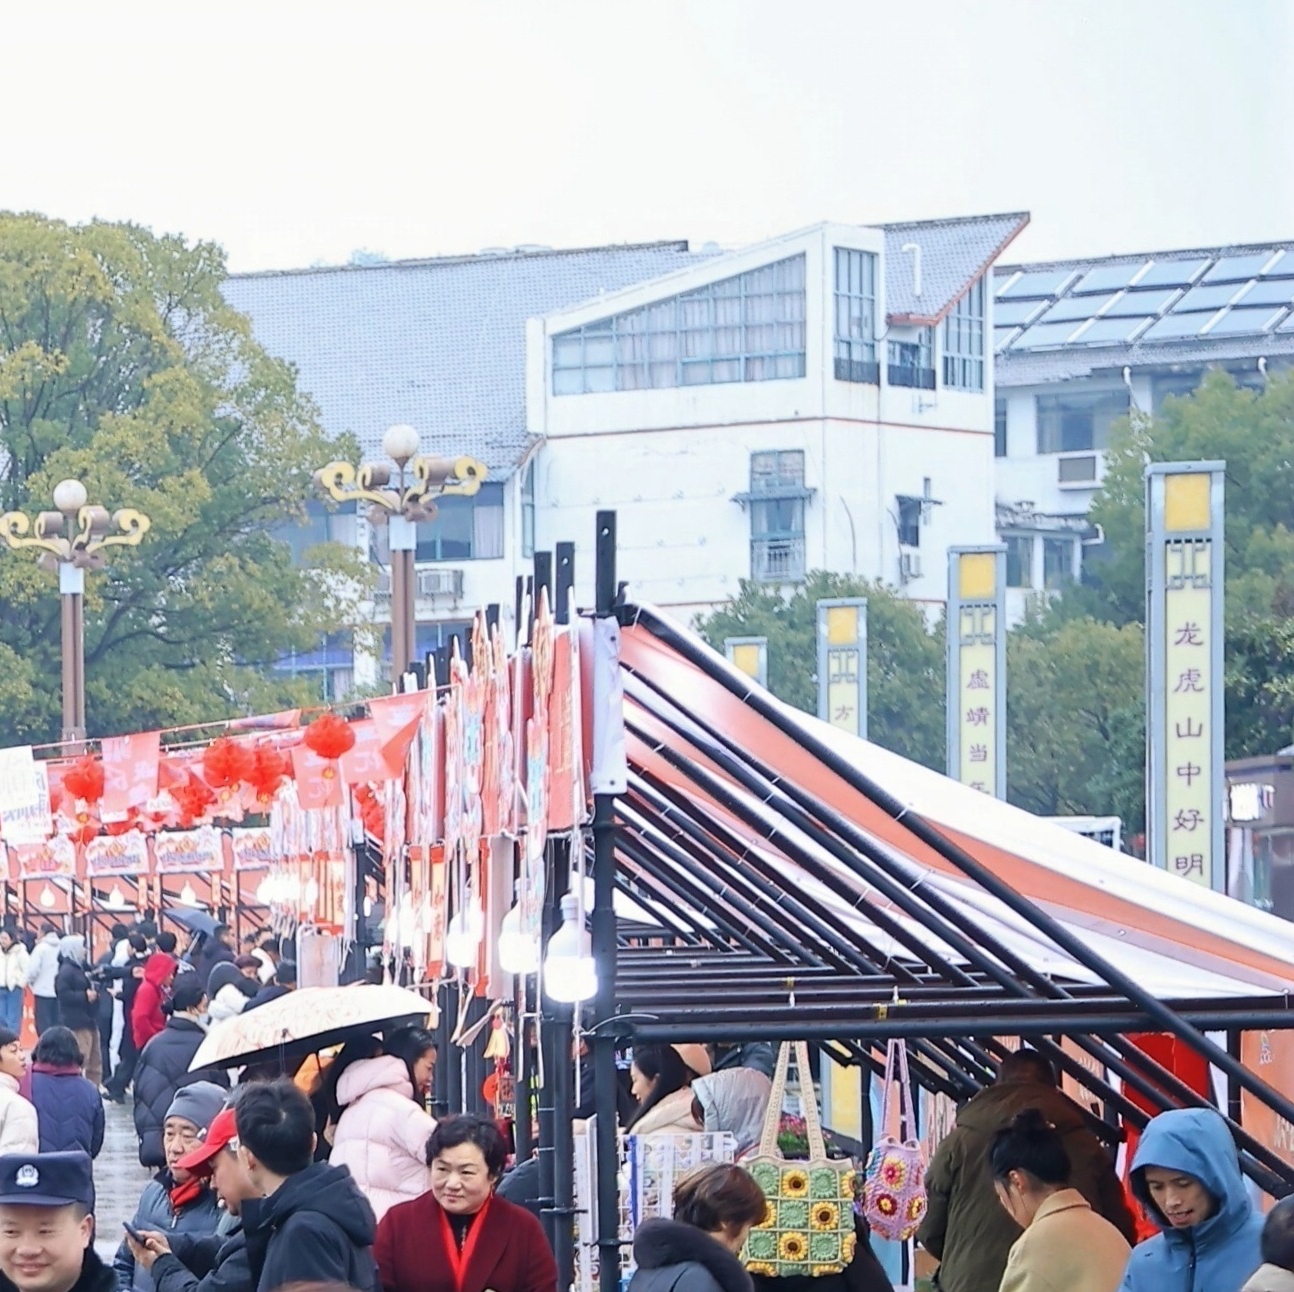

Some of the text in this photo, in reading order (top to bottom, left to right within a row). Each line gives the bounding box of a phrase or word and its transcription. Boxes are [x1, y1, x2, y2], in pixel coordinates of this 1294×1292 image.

[1174, 621, 1204, 877] 龙虎山中好明
